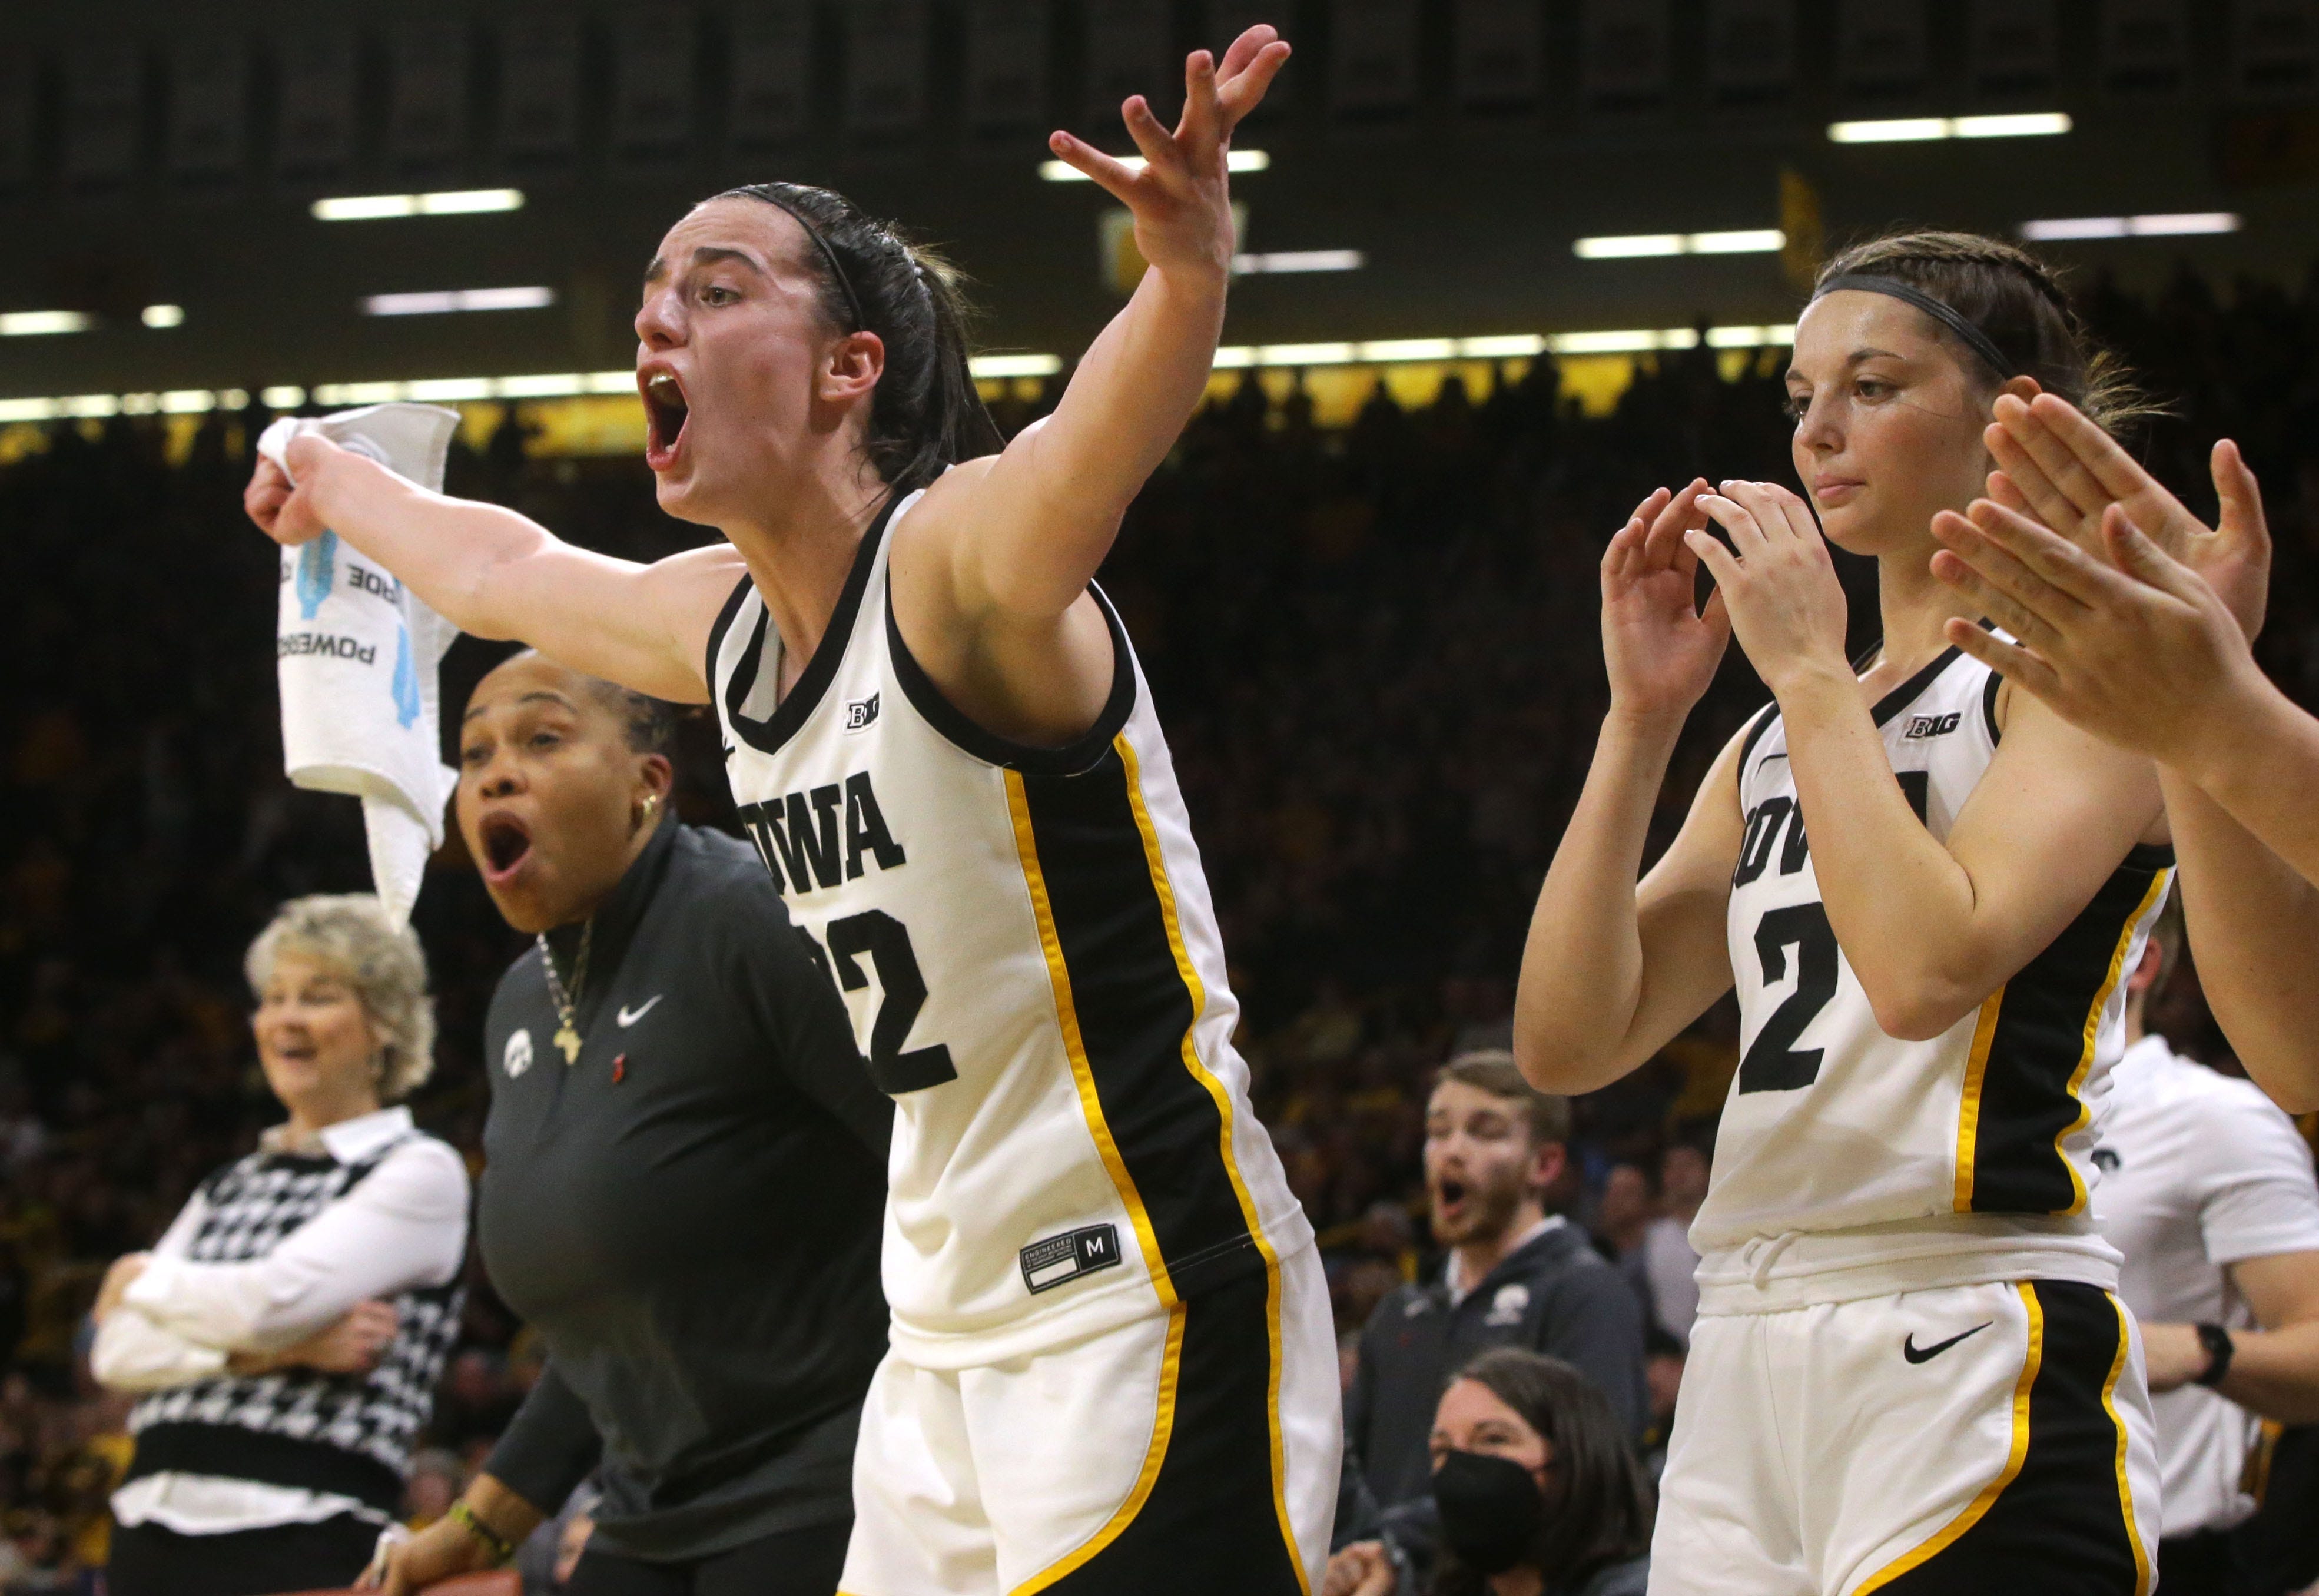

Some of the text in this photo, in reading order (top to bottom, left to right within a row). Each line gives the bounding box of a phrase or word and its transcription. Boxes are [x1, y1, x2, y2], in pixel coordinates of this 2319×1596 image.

[737, 770, 907, 895] OWA
[792, 909, 958, 1095] 2
[1739, 901, 1839, 1095] 2
[1086, 1236, 1104, 1257] M
